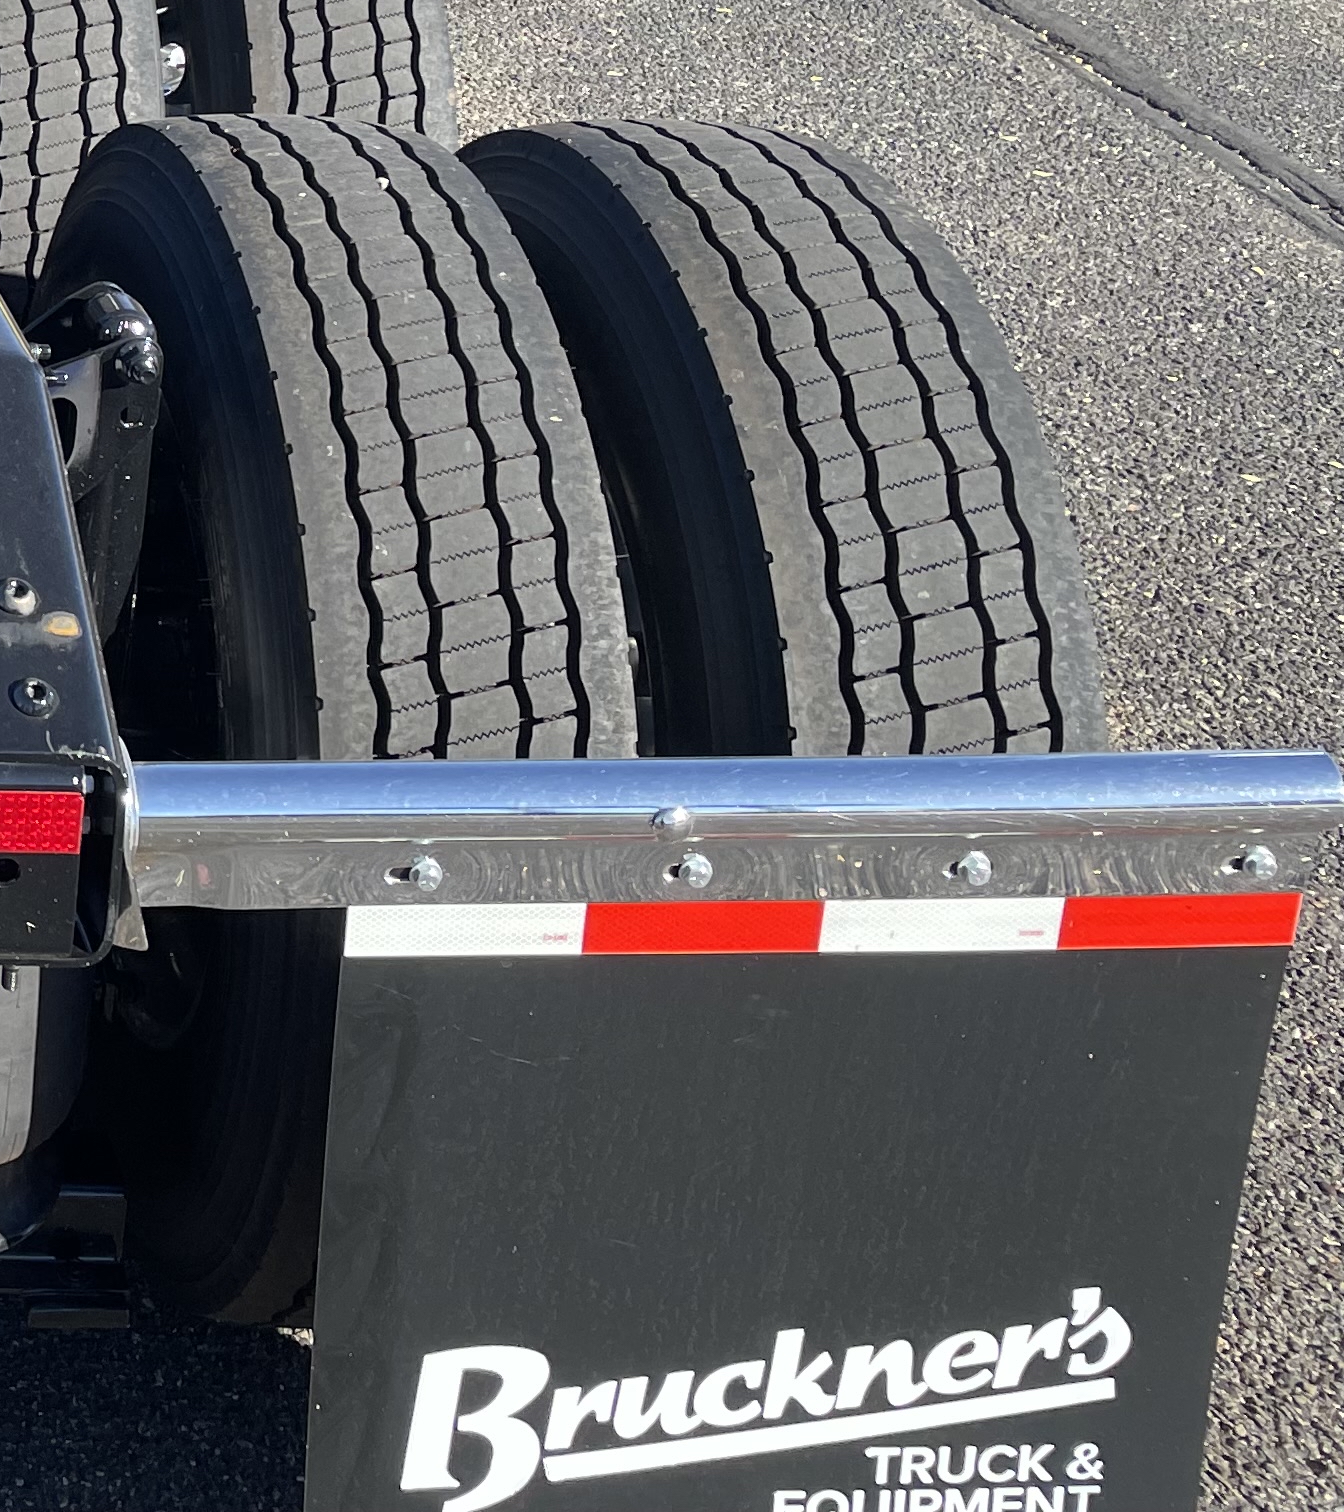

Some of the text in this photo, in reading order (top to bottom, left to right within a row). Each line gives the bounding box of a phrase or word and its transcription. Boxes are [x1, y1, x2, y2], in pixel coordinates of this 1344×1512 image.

[399, 1286, 1132, 1512] Bruckner's
[864, 1442, 1104, 1486] TRUCK &
